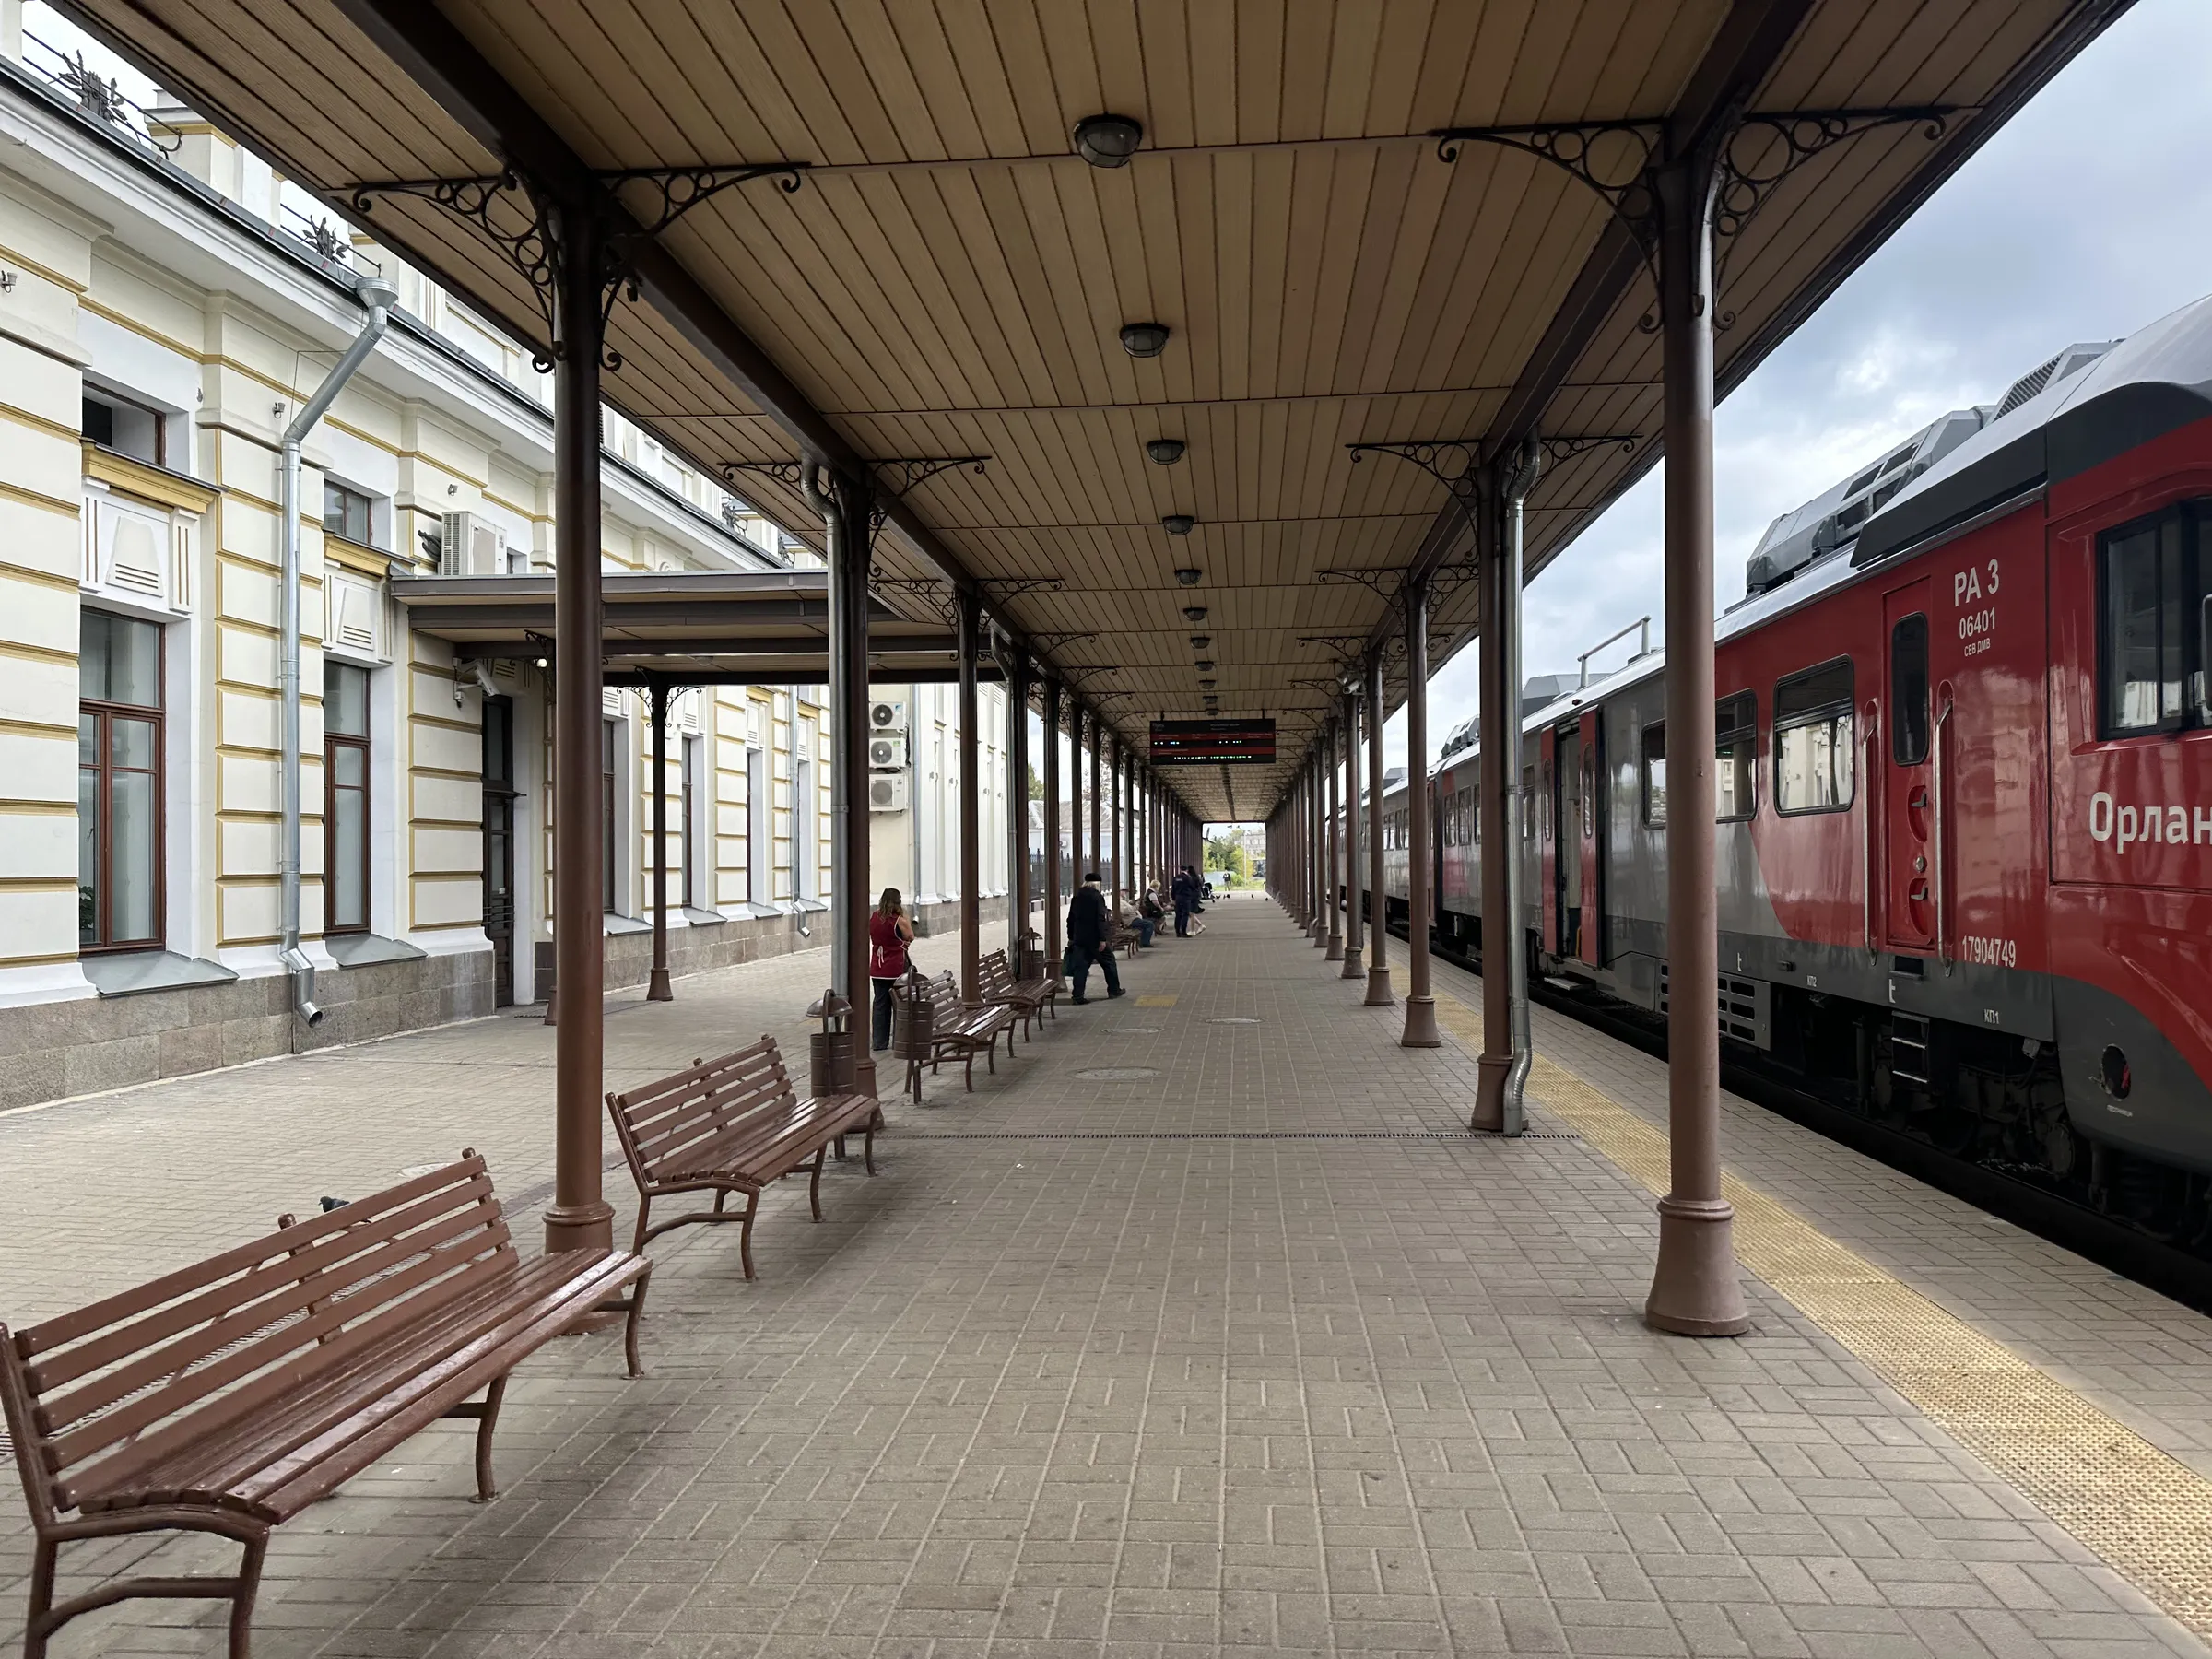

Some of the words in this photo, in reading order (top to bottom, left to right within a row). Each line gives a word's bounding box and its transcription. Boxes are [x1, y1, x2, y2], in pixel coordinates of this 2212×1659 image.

[1954, 566, 1982, 607] РА
[1987, 559, 1999, 594] 3
[1959, 606, 1995, 640] 06401
[1964, 642, 1977, 657] СЕВ
[1977, 638, 1991, 655] ДМВ
[2089, 791, 2212, 855] Орлан
[1962, 935, 2017, 968] 17904749
[1983, 1008, 2000, 1025] КП1
